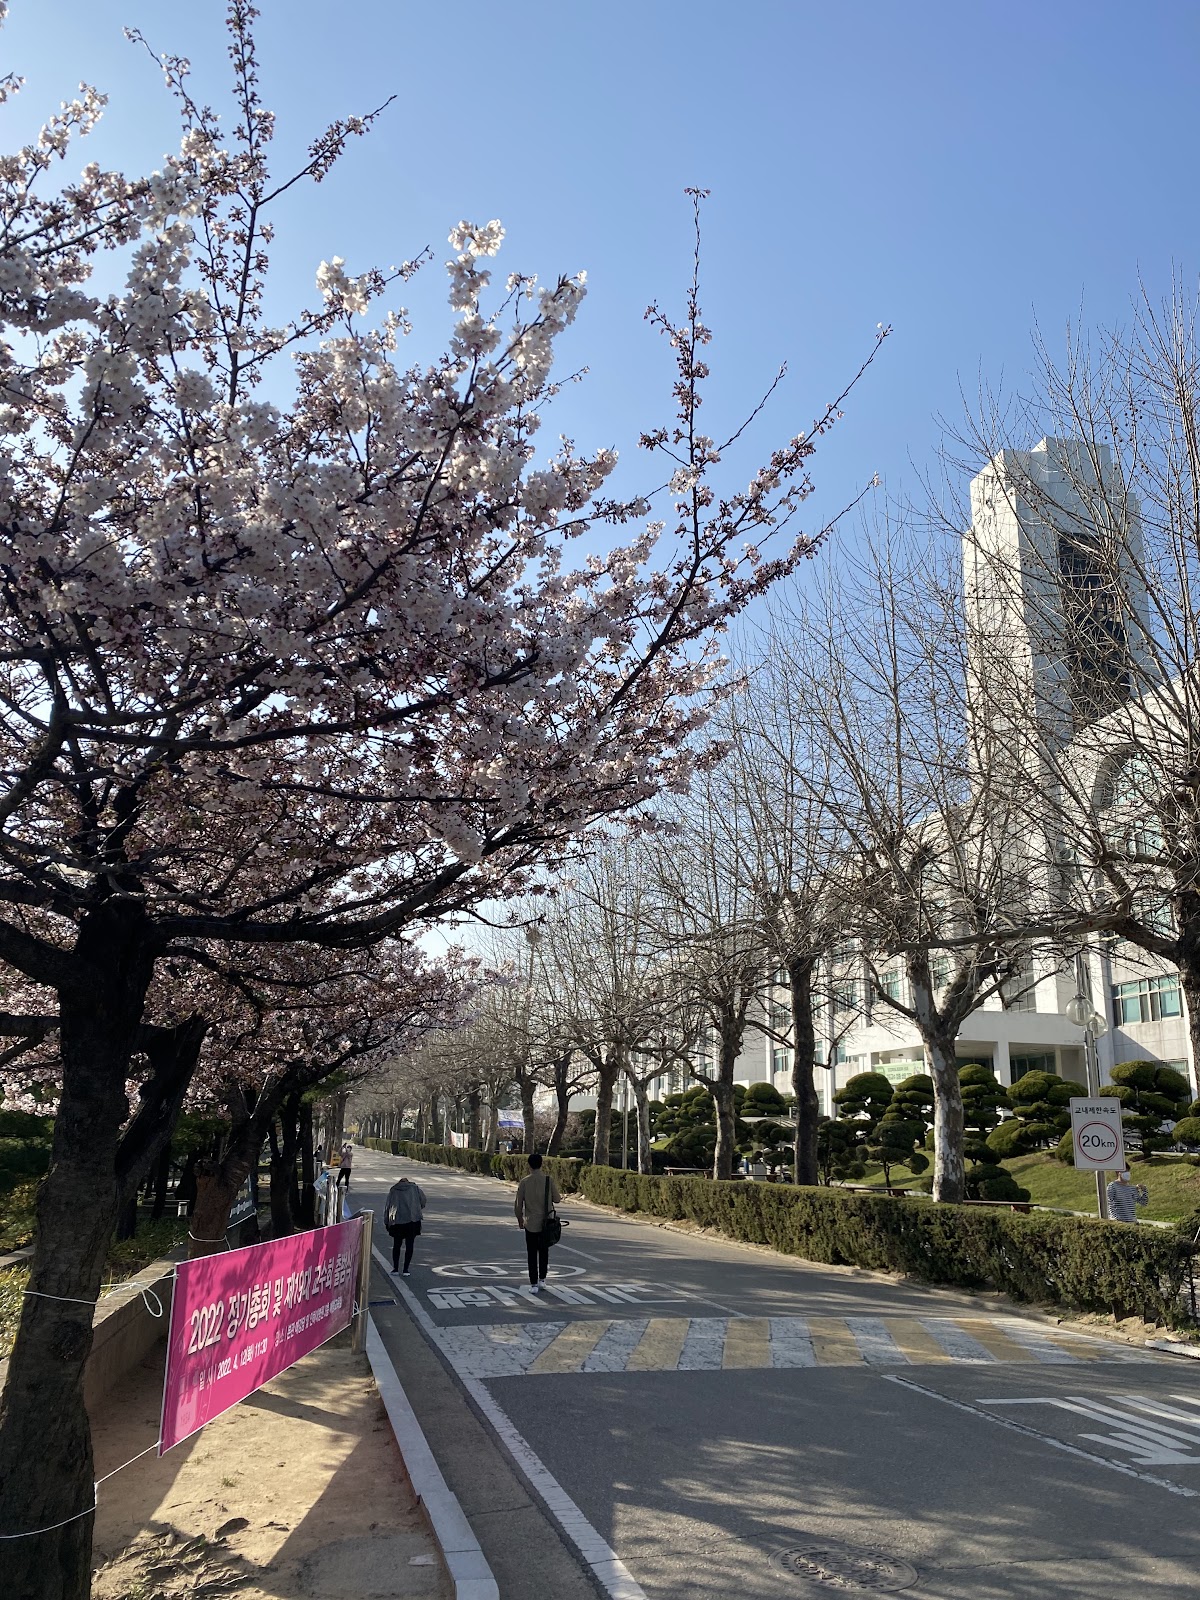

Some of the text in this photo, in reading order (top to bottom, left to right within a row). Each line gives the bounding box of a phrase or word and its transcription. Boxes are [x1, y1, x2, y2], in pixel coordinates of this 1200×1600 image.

[1074, 1106, 1117, 1115] 교내제한속도
[187, 1300, 224, 1356] 2022
[226, 1280, 270, 1339] 정기총회
[272, 1276, 284, 1317] 및
[284, 1265, 312, 1309] 제19대
[311, 1257, 334, 1296] 교수회
